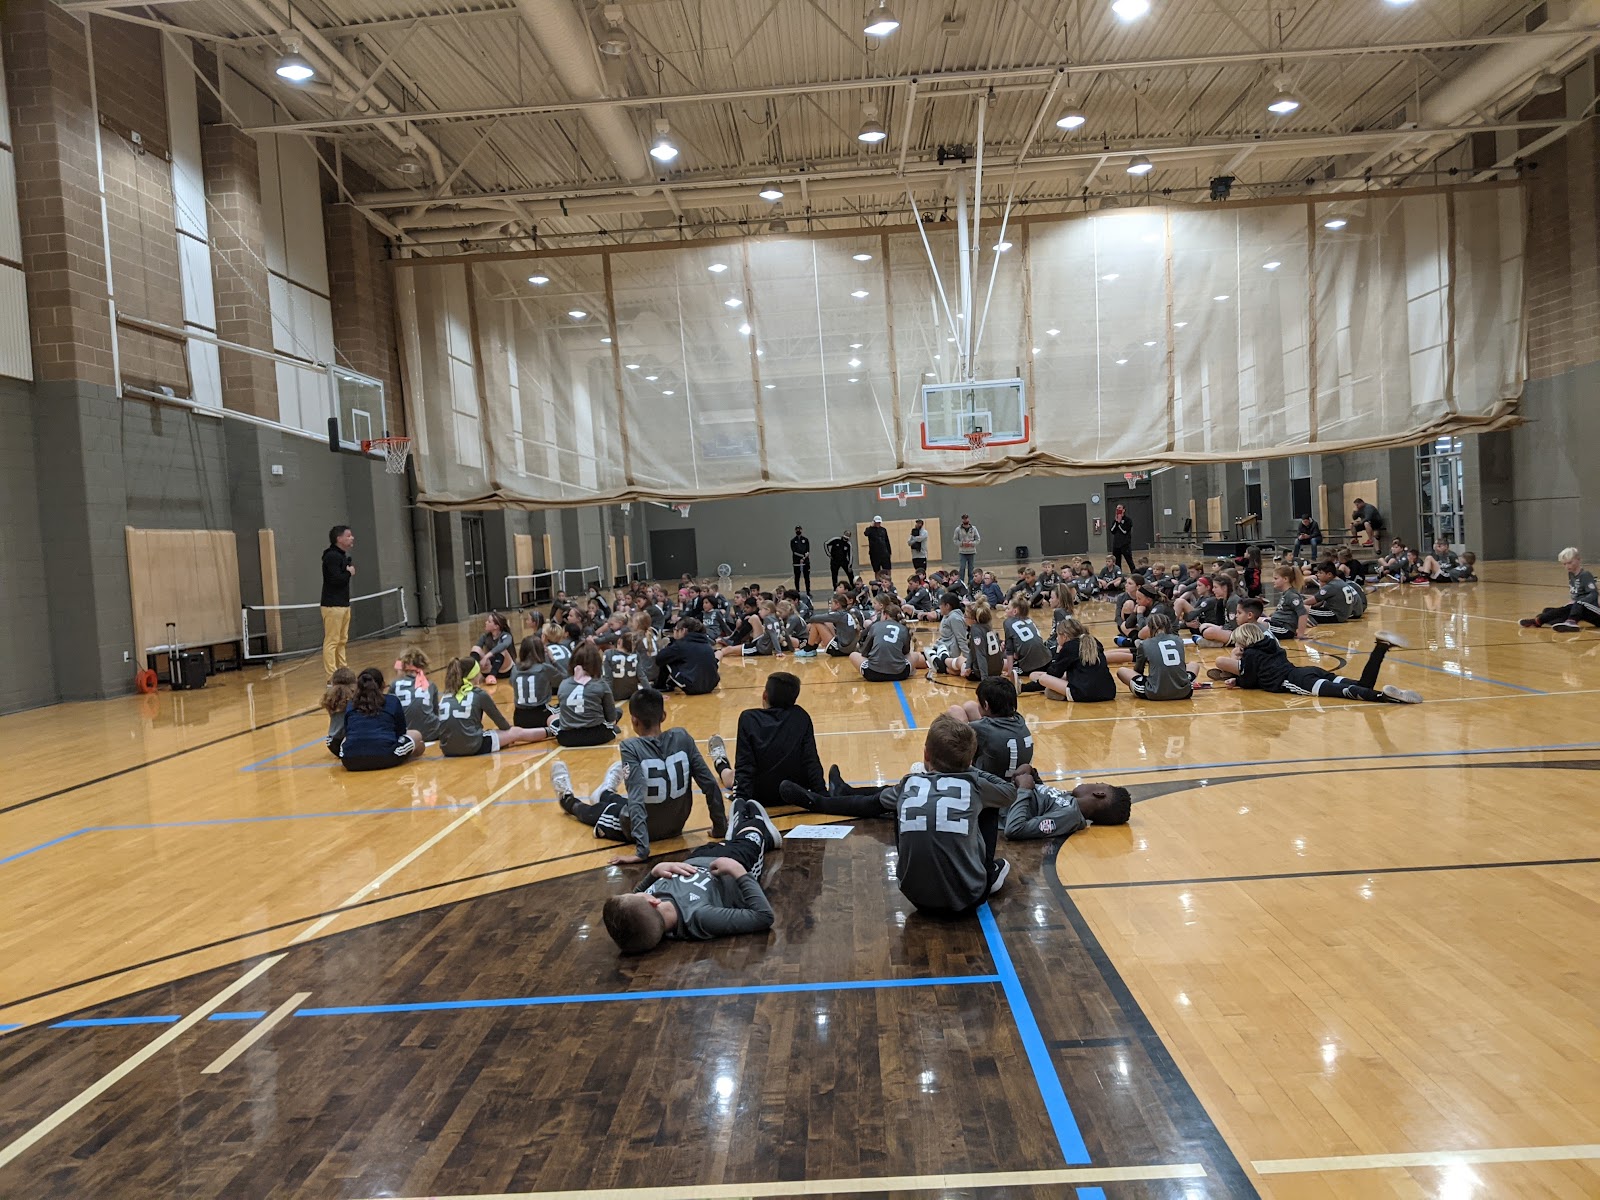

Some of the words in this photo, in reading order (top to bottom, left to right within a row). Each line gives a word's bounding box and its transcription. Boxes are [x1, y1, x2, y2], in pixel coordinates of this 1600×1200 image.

[883, 624, 900, 644] 3
[611, 654, 638, 679] 33
[1158, 640, 1181, 667] 6
[395, 679, 430, 707] 54
[515, 675, 538, 705] 11
[566, 684, 585, 714] 4
[439, 690, 474, 721] 53
[640, 750, 690, 804] 60
[900, 775, 971, 835] 22
